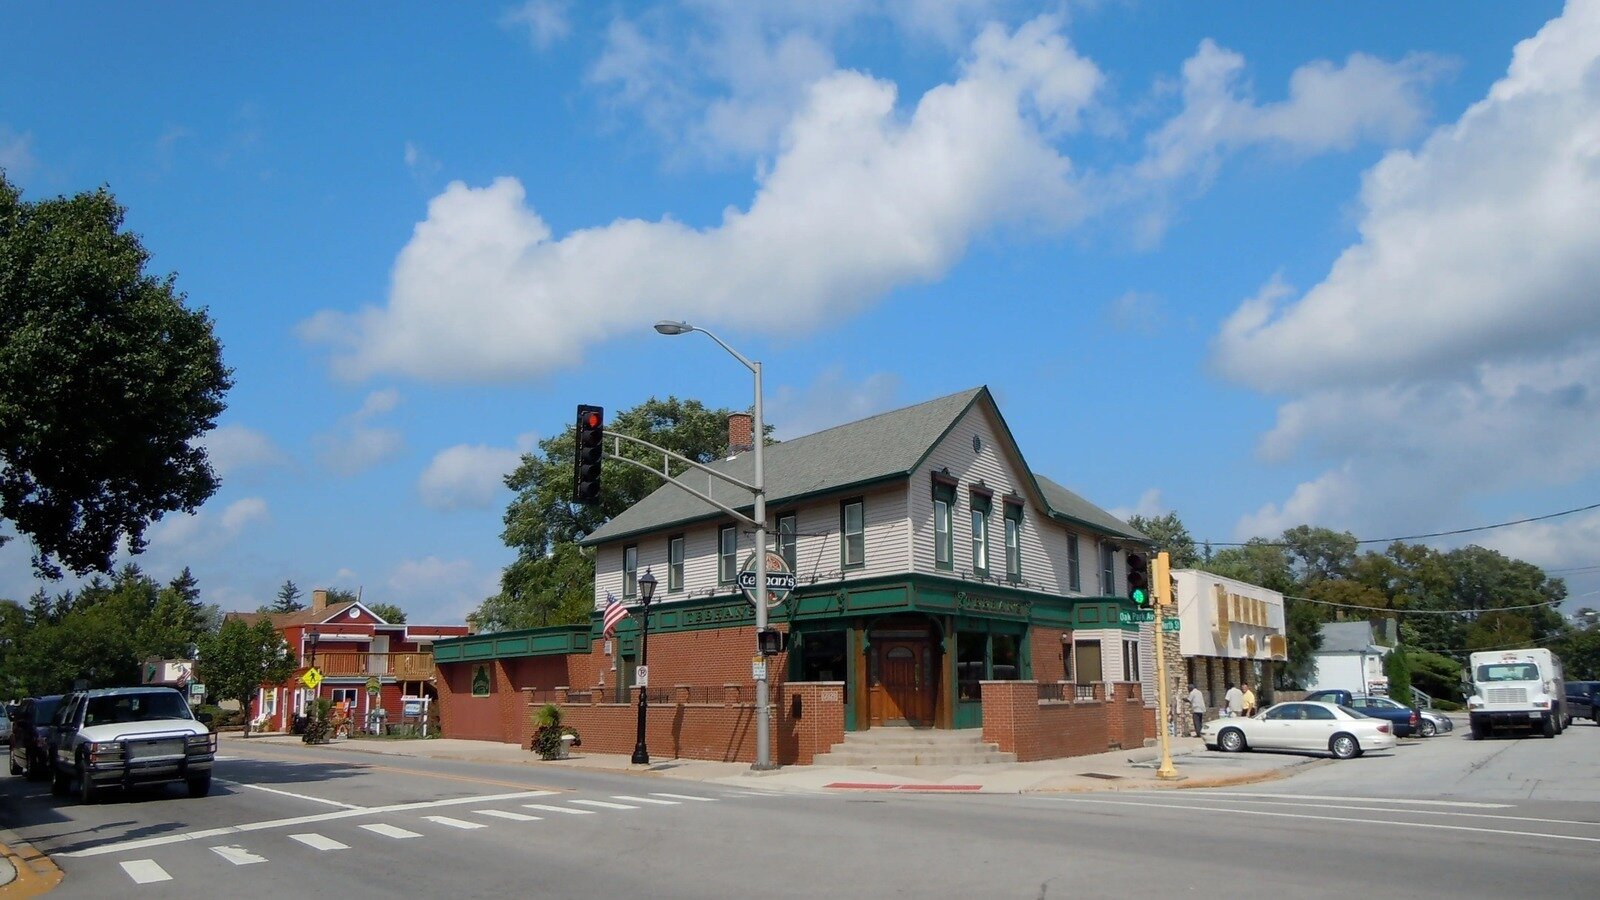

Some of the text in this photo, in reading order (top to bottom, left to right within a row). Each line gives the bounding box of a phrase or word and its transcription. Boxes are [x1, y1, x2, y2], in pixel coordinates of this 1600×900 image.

[742, 575, 795, 586] tean's
[1119, 612, 1131, 621] Oak
[1132, 612, 1145, 621] Park
